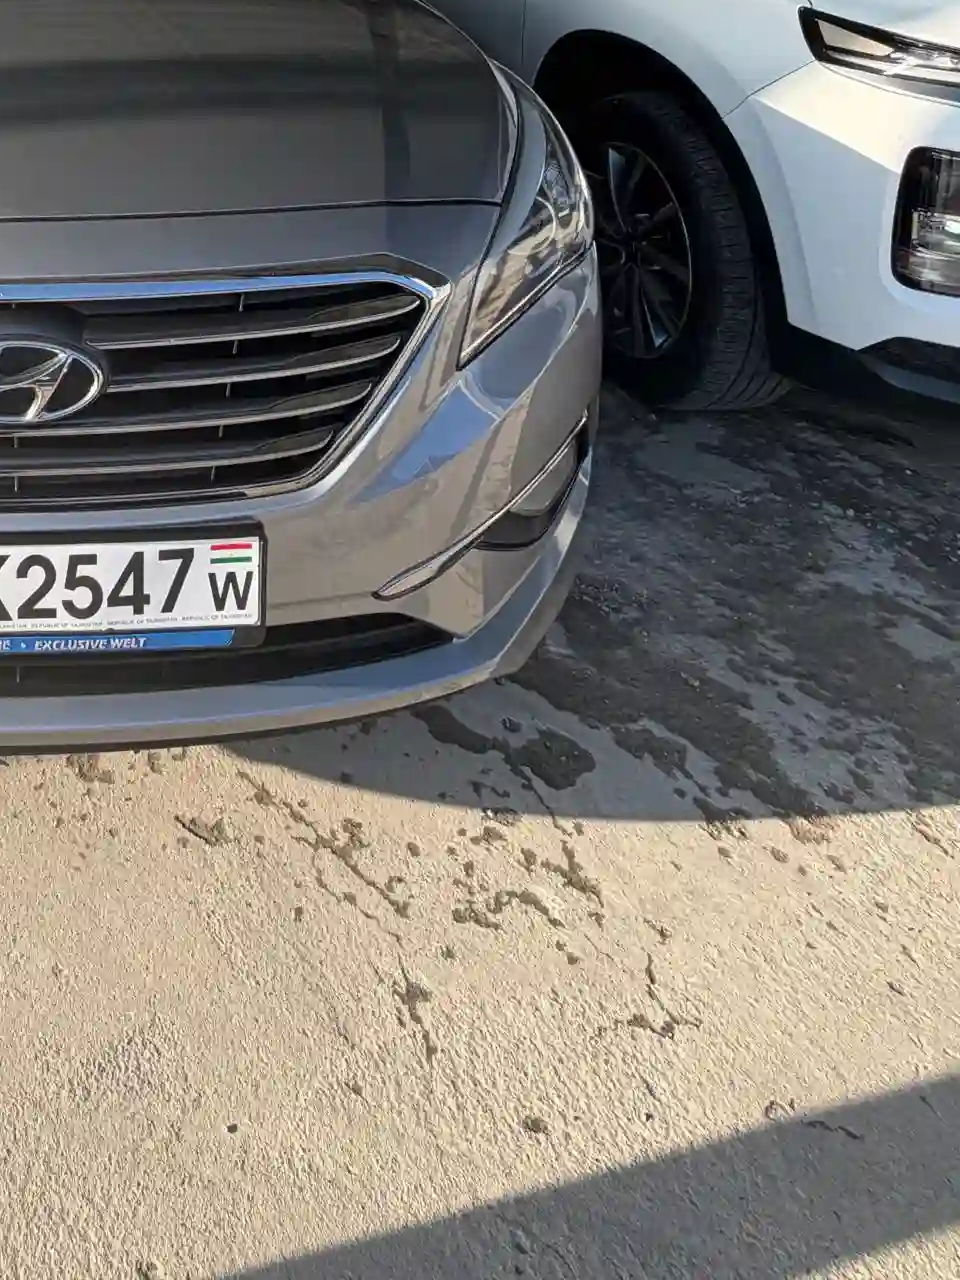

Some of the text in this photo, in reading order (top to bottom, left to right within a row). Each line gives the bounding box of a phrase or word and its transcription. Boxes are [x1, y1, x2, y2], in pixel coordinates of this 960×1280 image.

[207, 570, 254, 612] W
[34, 639, 108, 652] EXCLUSIVE
[109, 637, 147, 650] WELT
